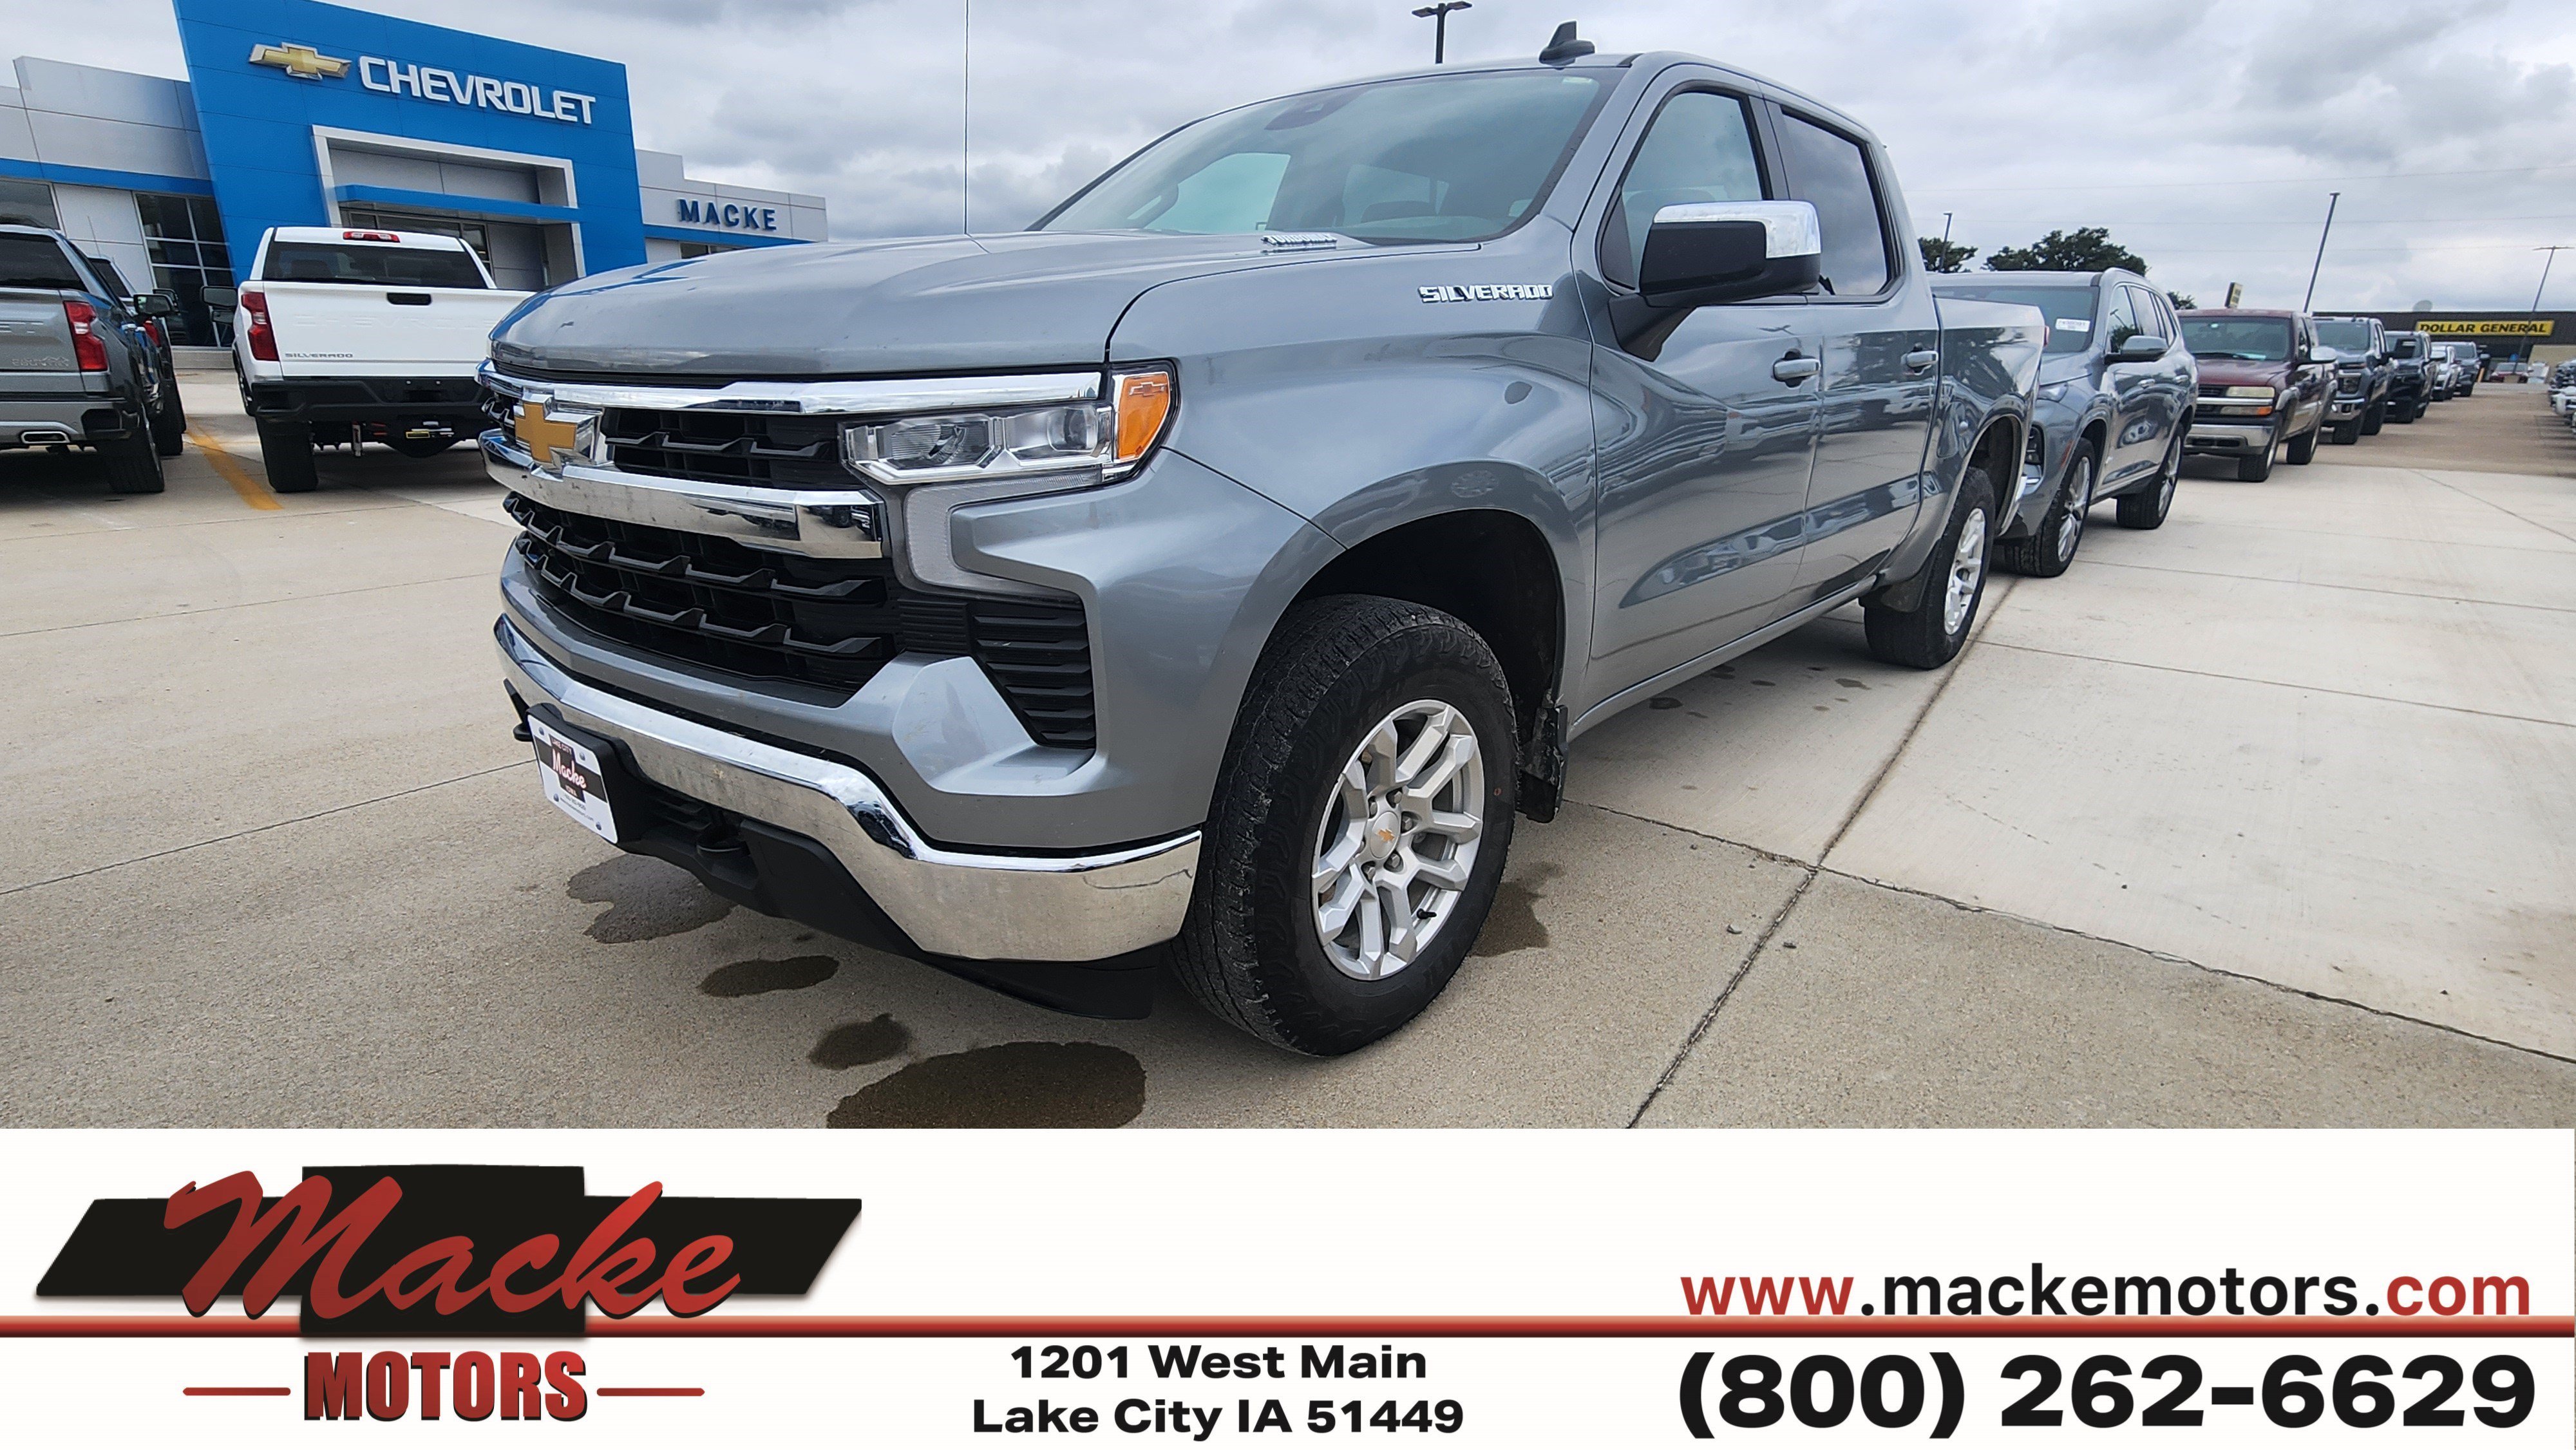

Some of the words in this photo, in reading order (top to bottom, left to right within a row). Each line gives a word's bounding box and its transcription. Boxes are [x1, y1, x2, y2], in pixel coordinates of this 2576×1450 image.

[359, 55, 596, 124] CHEVROLET
[677, 198, 777, 231] MACKE
[1418, 284, 1553, 303] SILVERADO
[2420, 323, 2476, 333] DOLLAR
[2480, 323, 2546, 333] GENERAL
[552, 748, 587, 789] Macke
